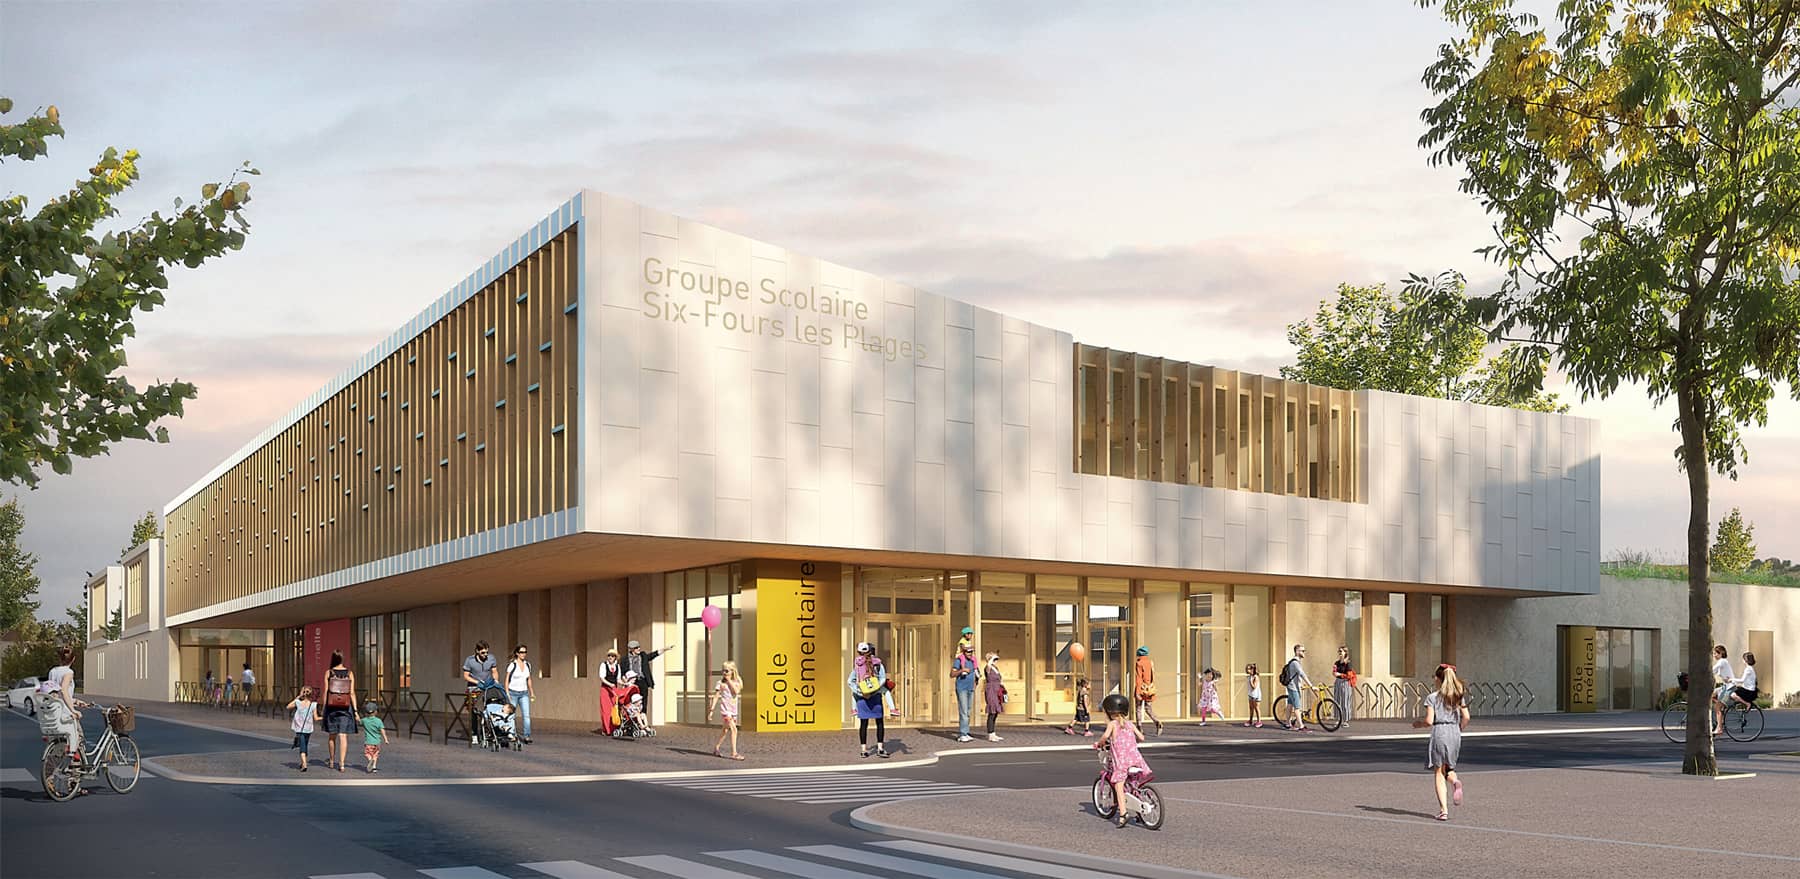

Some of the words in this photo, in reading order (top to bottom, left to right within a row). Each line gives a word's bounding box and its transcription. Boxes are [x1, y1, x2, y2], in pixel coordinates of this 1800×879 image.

[643, 257, 750, 306] Groupe
[759, 278, 868, 320] Scolaire
[643, 291, 785, 338] Six-Fours
[795, 315, 833, 346] les
[843, 323, 928, 362] Plages
[788, 561, 816, 725] Élémentaire
[1584, 636, 1594, 704] médical
[760, 653, 788, 725] École
[1573, 666, 1583, 704] Pôle
